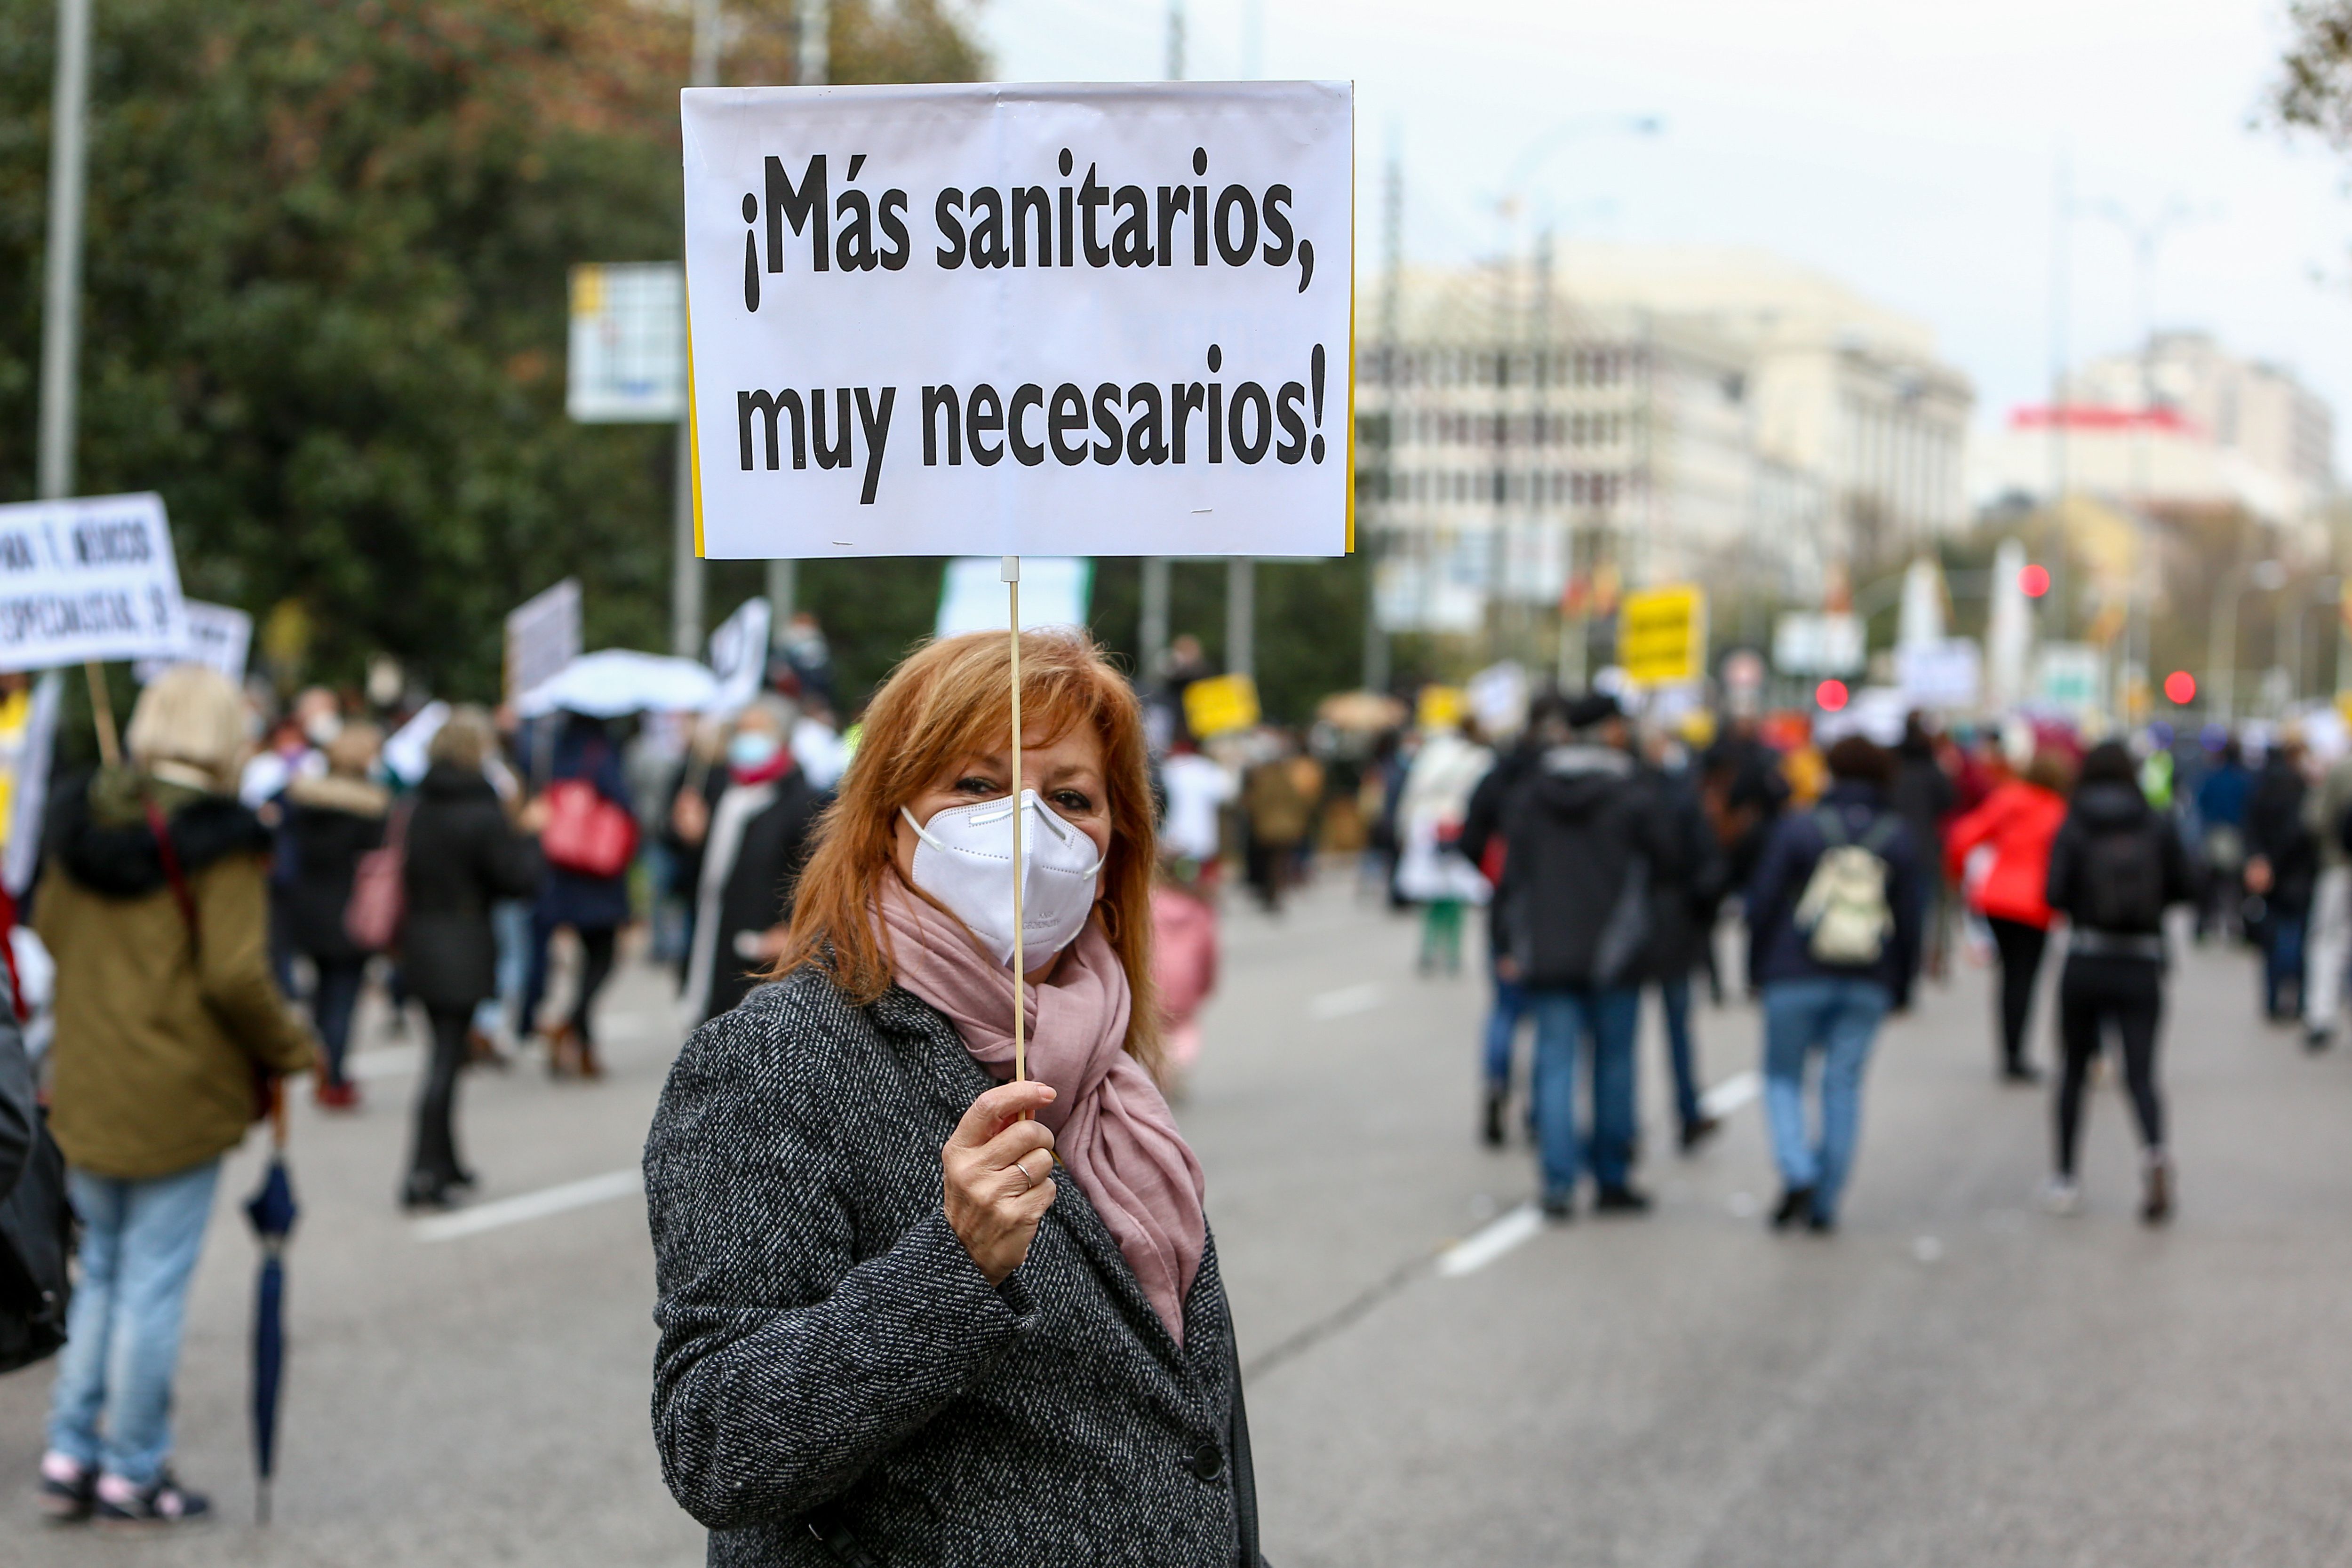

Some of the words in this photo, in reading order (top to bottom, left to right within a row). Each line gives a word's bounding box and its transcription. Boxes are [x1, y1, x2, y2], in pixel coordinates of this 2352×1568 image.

[741, 153, 910, 313] ¡Más
[935, 147, 1315, 294] sanitarios,
[737, 386, 897, 505] muy
[921, 343, 1326, 467] necesarios!
